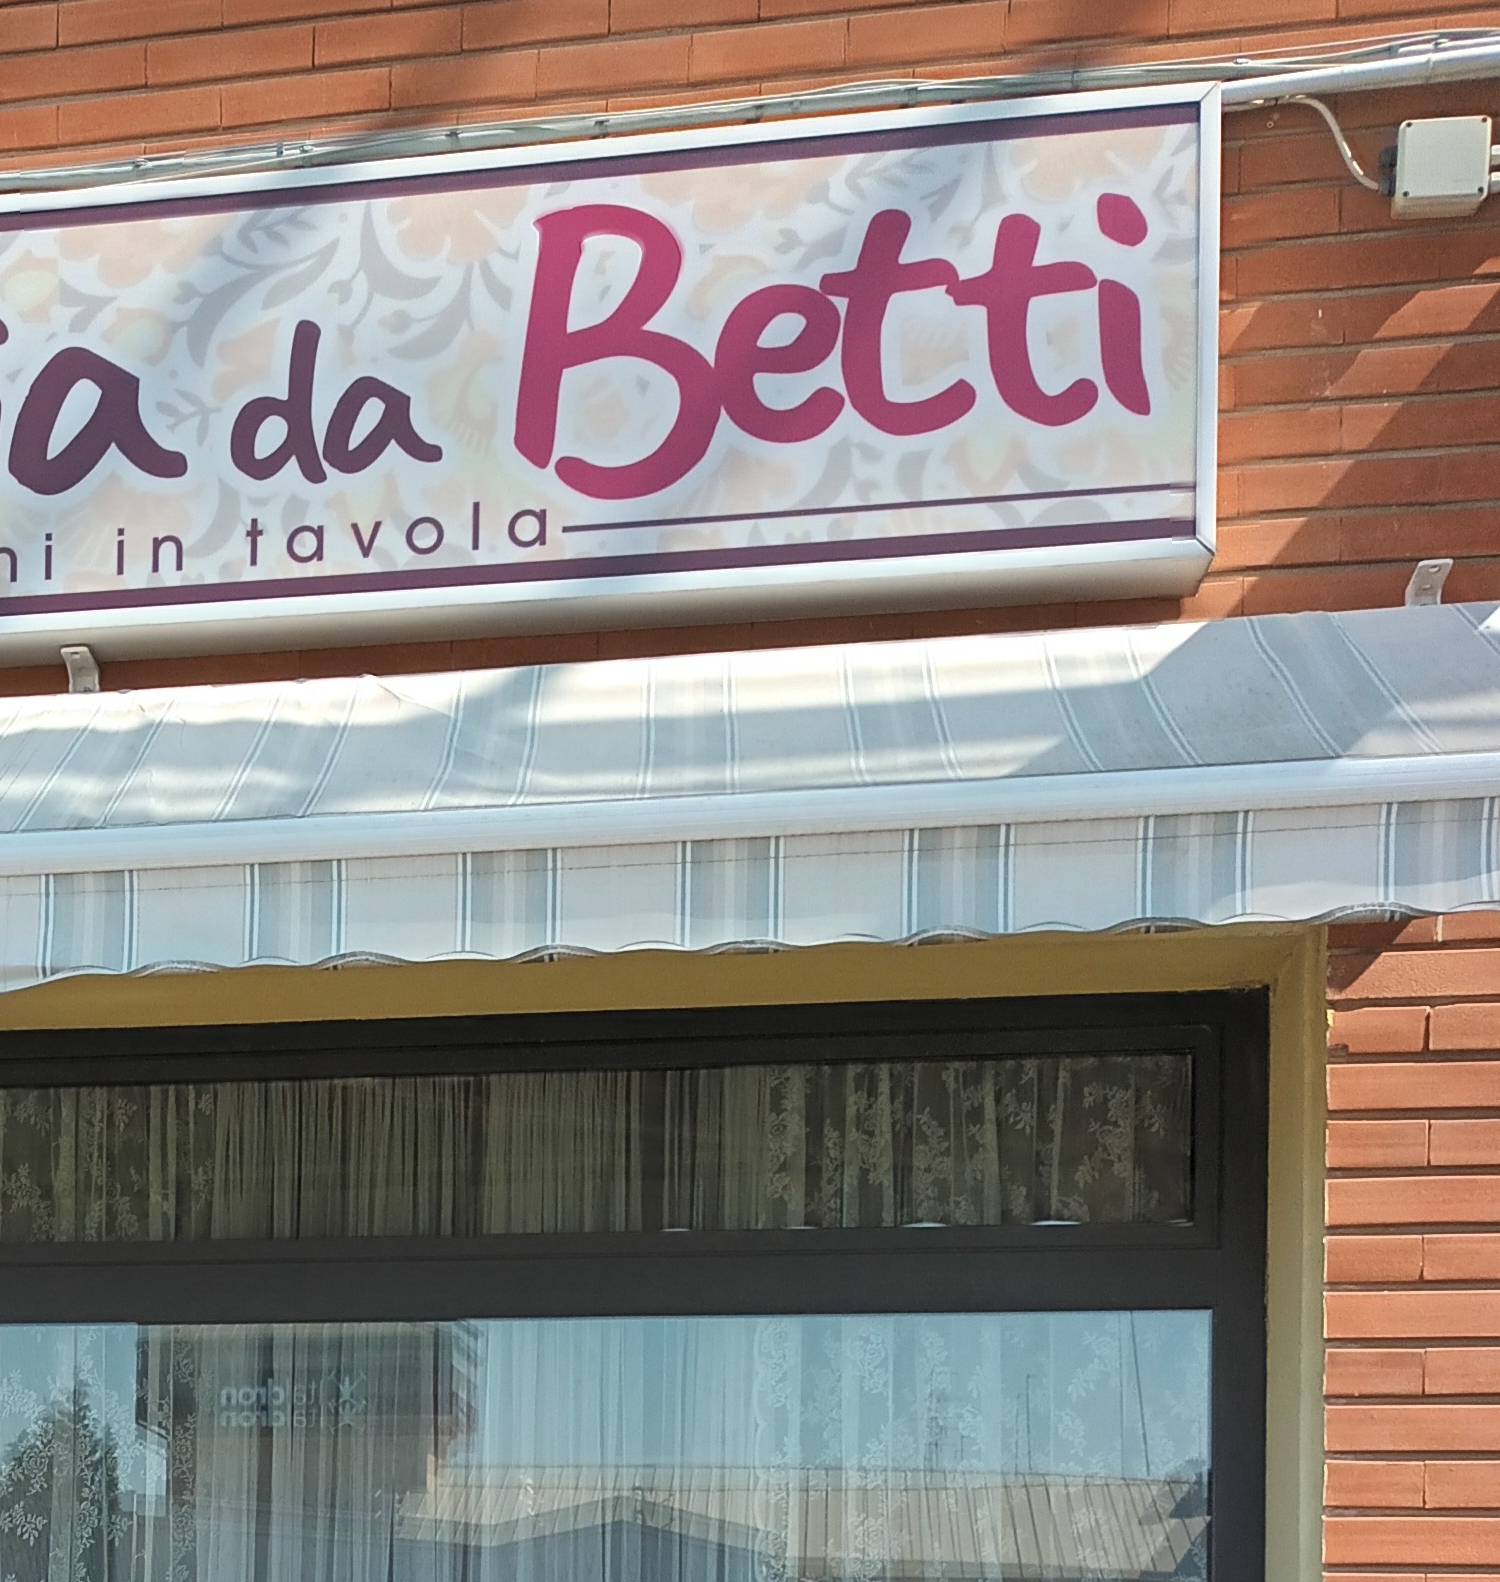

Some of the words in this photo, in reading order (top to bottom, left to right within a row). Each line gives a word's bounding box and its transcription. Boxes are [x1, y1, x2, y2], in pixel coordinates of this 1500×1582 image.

[230, 320, 444, 484] da
[513, 192, 1152, 501] Betti
[116, 527, 184, 578] in
[245, 501, 549, 567] tavola
